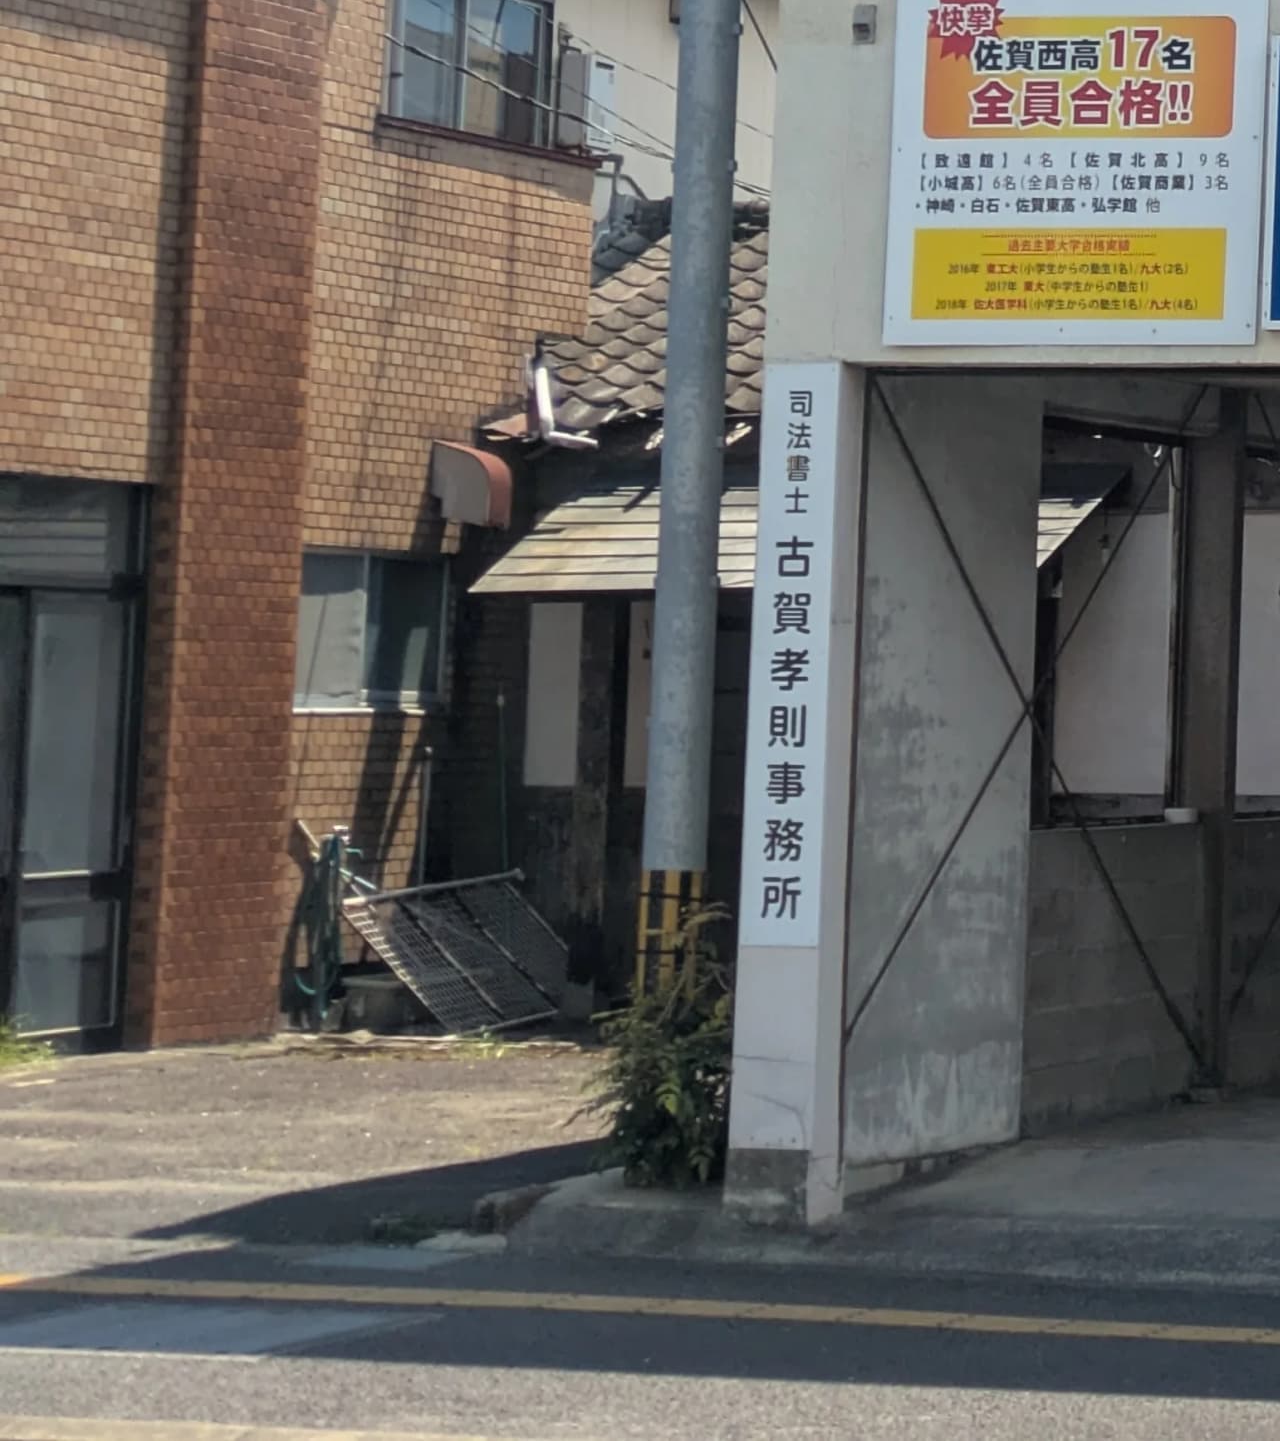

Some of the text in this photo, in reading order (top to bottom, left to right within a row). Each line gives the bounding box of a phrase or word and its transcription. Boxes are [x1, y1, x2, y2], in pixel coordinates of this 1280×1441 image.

[939, 6, 995, 34] 快挙
[974, 28, 1193, 72] 佐賀西高17名
[970, 80, 1193, 127] 全員合格!!
[784, 390, 813, 514] 司法書士
[760, 534, 815, 920] 古賀孝則事務所
